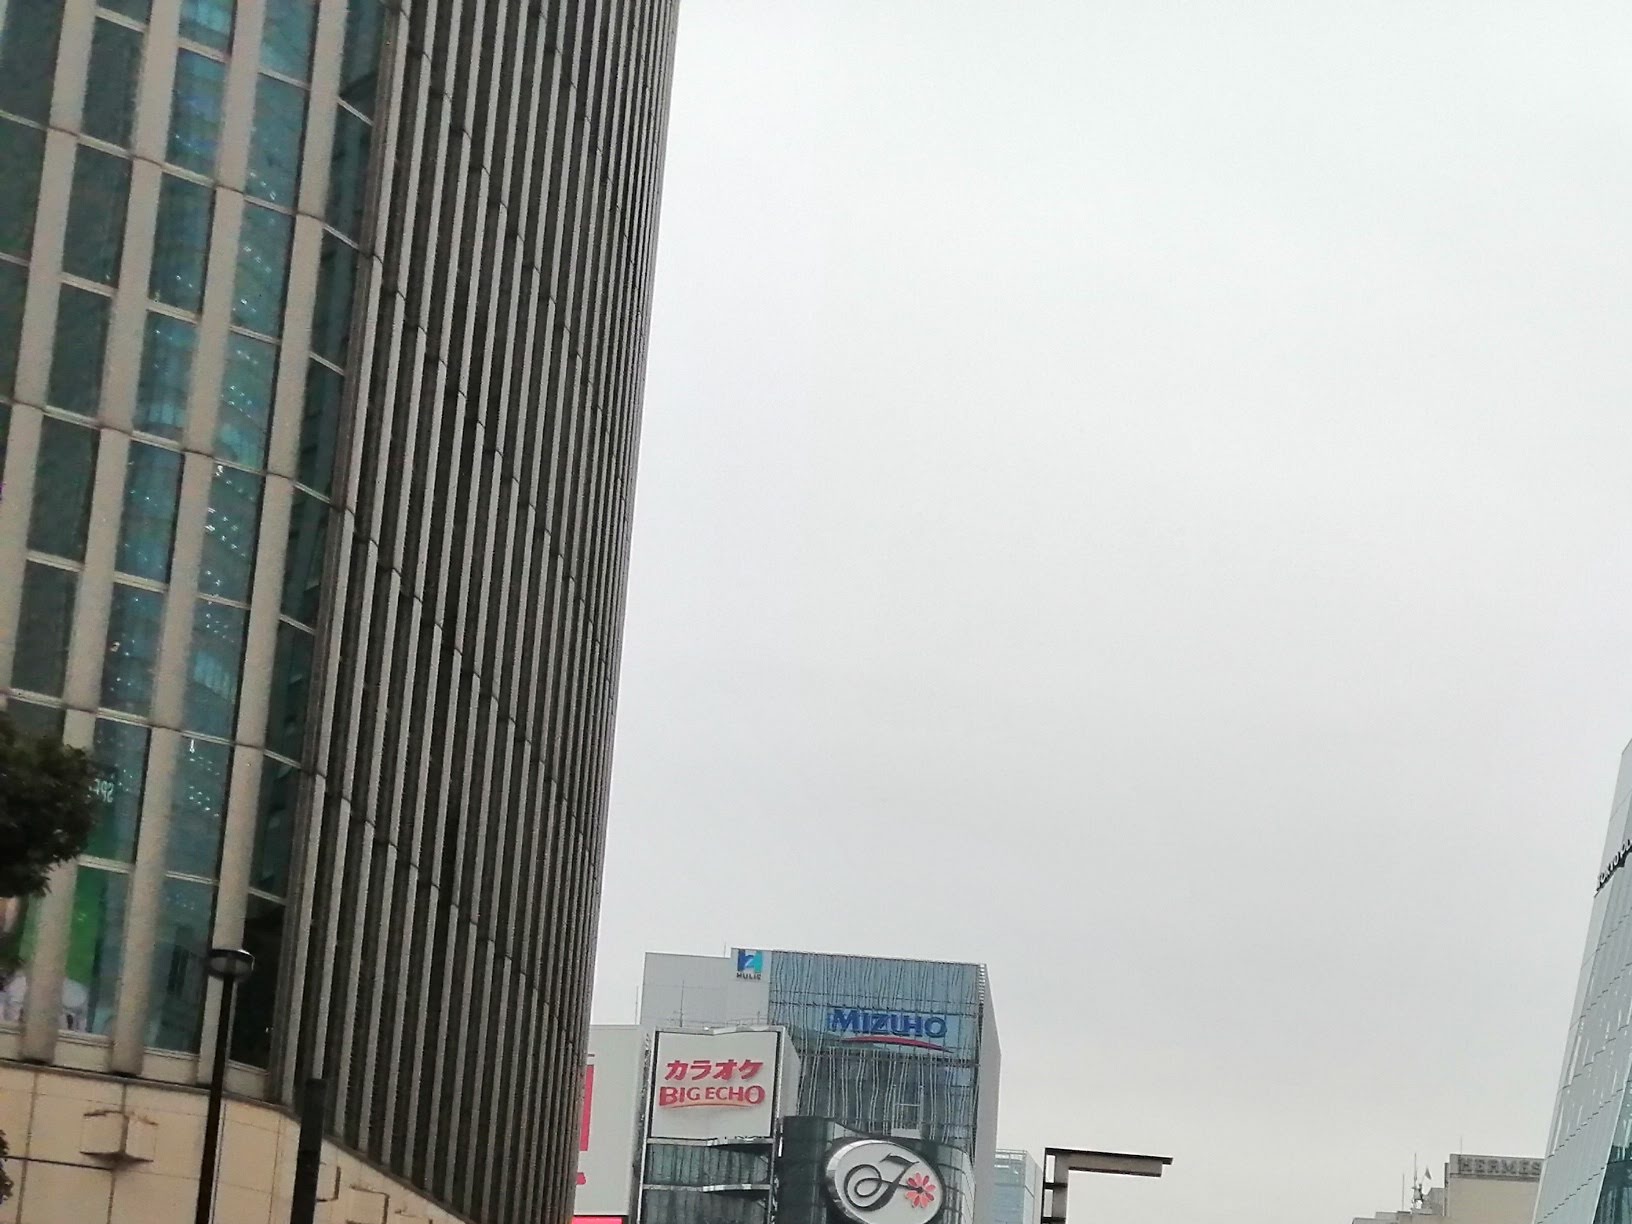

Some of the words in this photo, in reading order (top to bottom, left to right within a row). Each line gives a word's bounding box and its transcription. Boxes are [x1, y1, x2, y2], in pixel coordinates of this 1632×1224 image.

[829, 1008, 948, 1039] MIZUHO
[664, 1058, 765, 1081] カラオケ
[658, 1085, 701, 1107] BIG
[704, 1084, 766, 1105] ECHO
